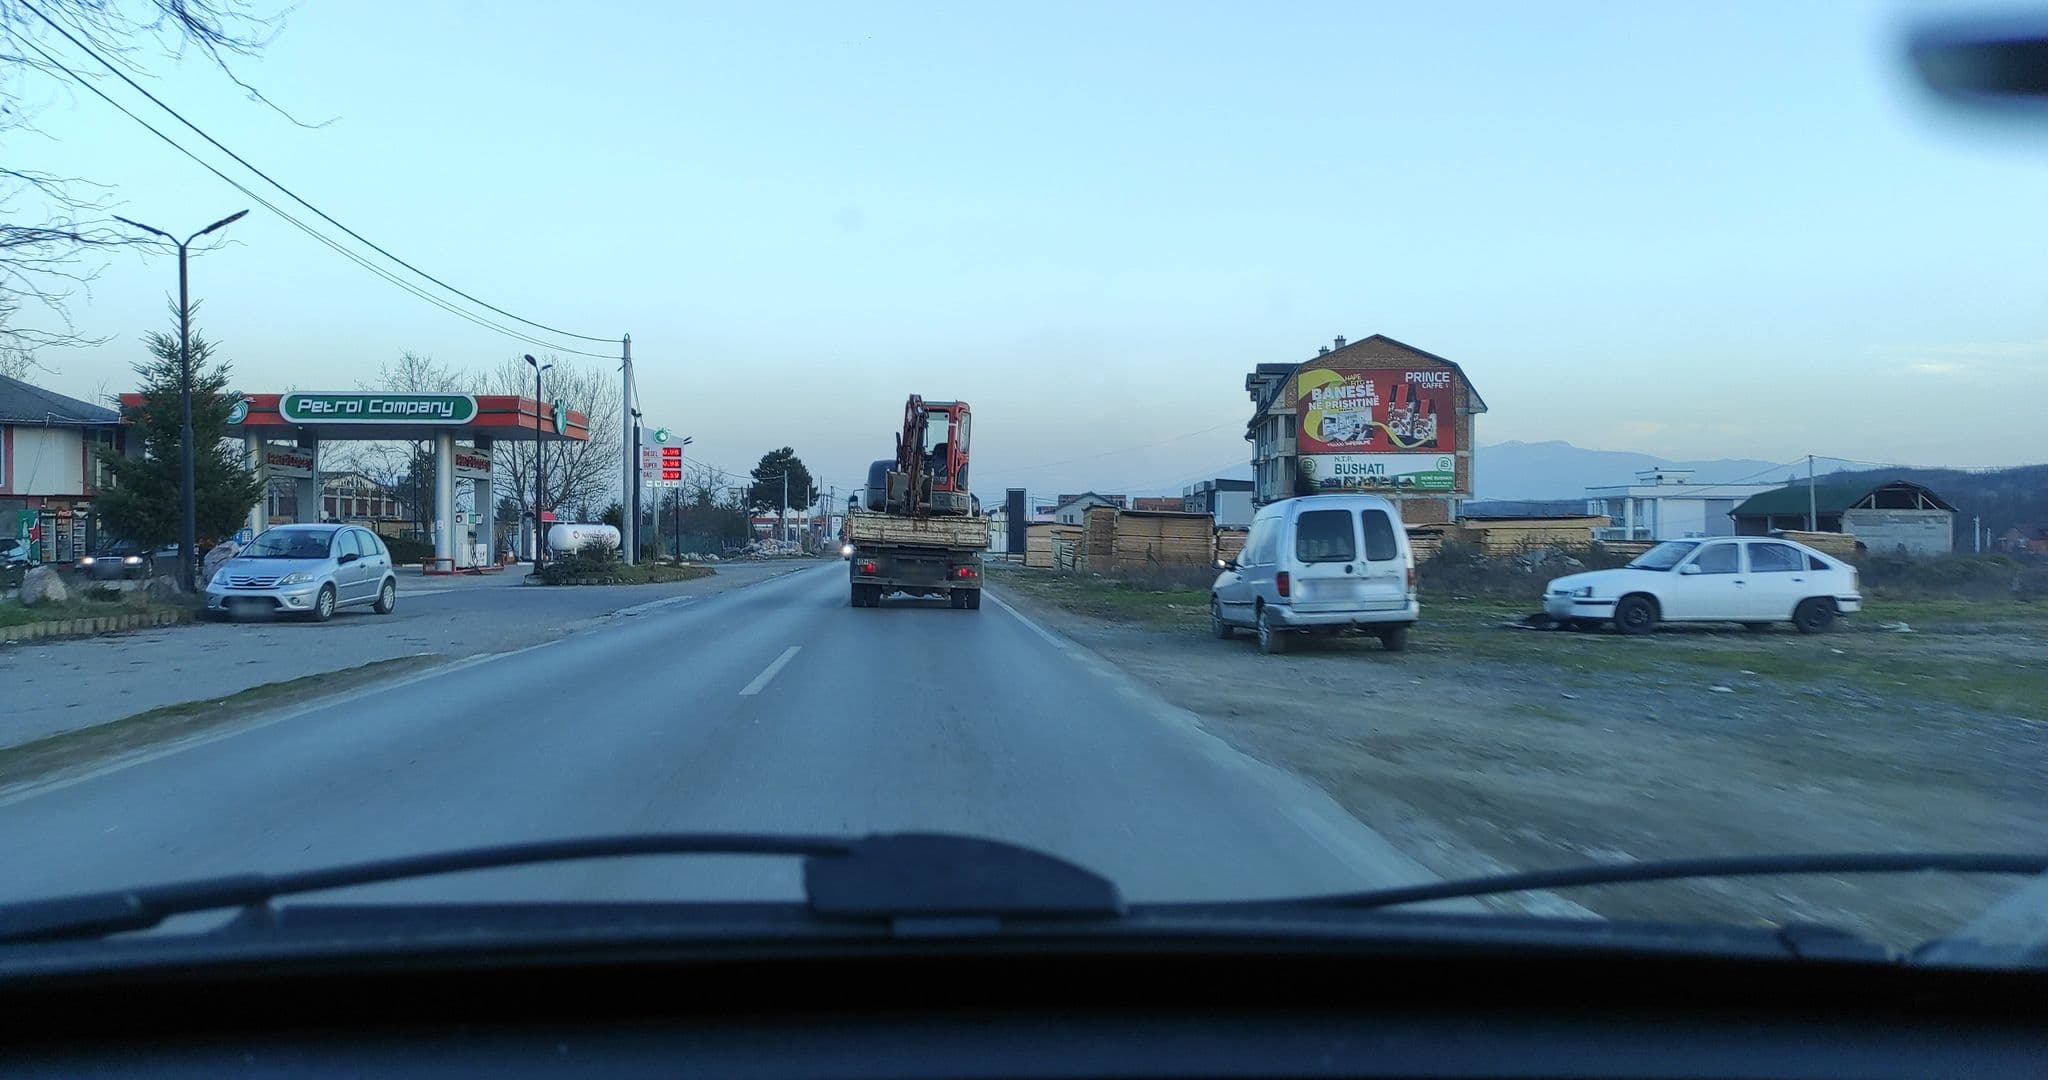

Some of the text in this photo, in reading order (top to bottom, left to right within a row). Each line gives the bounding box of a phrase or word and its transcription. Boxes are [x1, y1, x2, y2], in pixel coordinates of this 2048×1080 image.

[1405, 371, 1450, 382] PRINCE
[1311, 380, 1375, 400] BANESË
[297, 399, 454, 417] Petrol Company
[1325, 395, 1380, 409] PRISHTINË
[1334, 463, 1385, 475] BUSHATI
